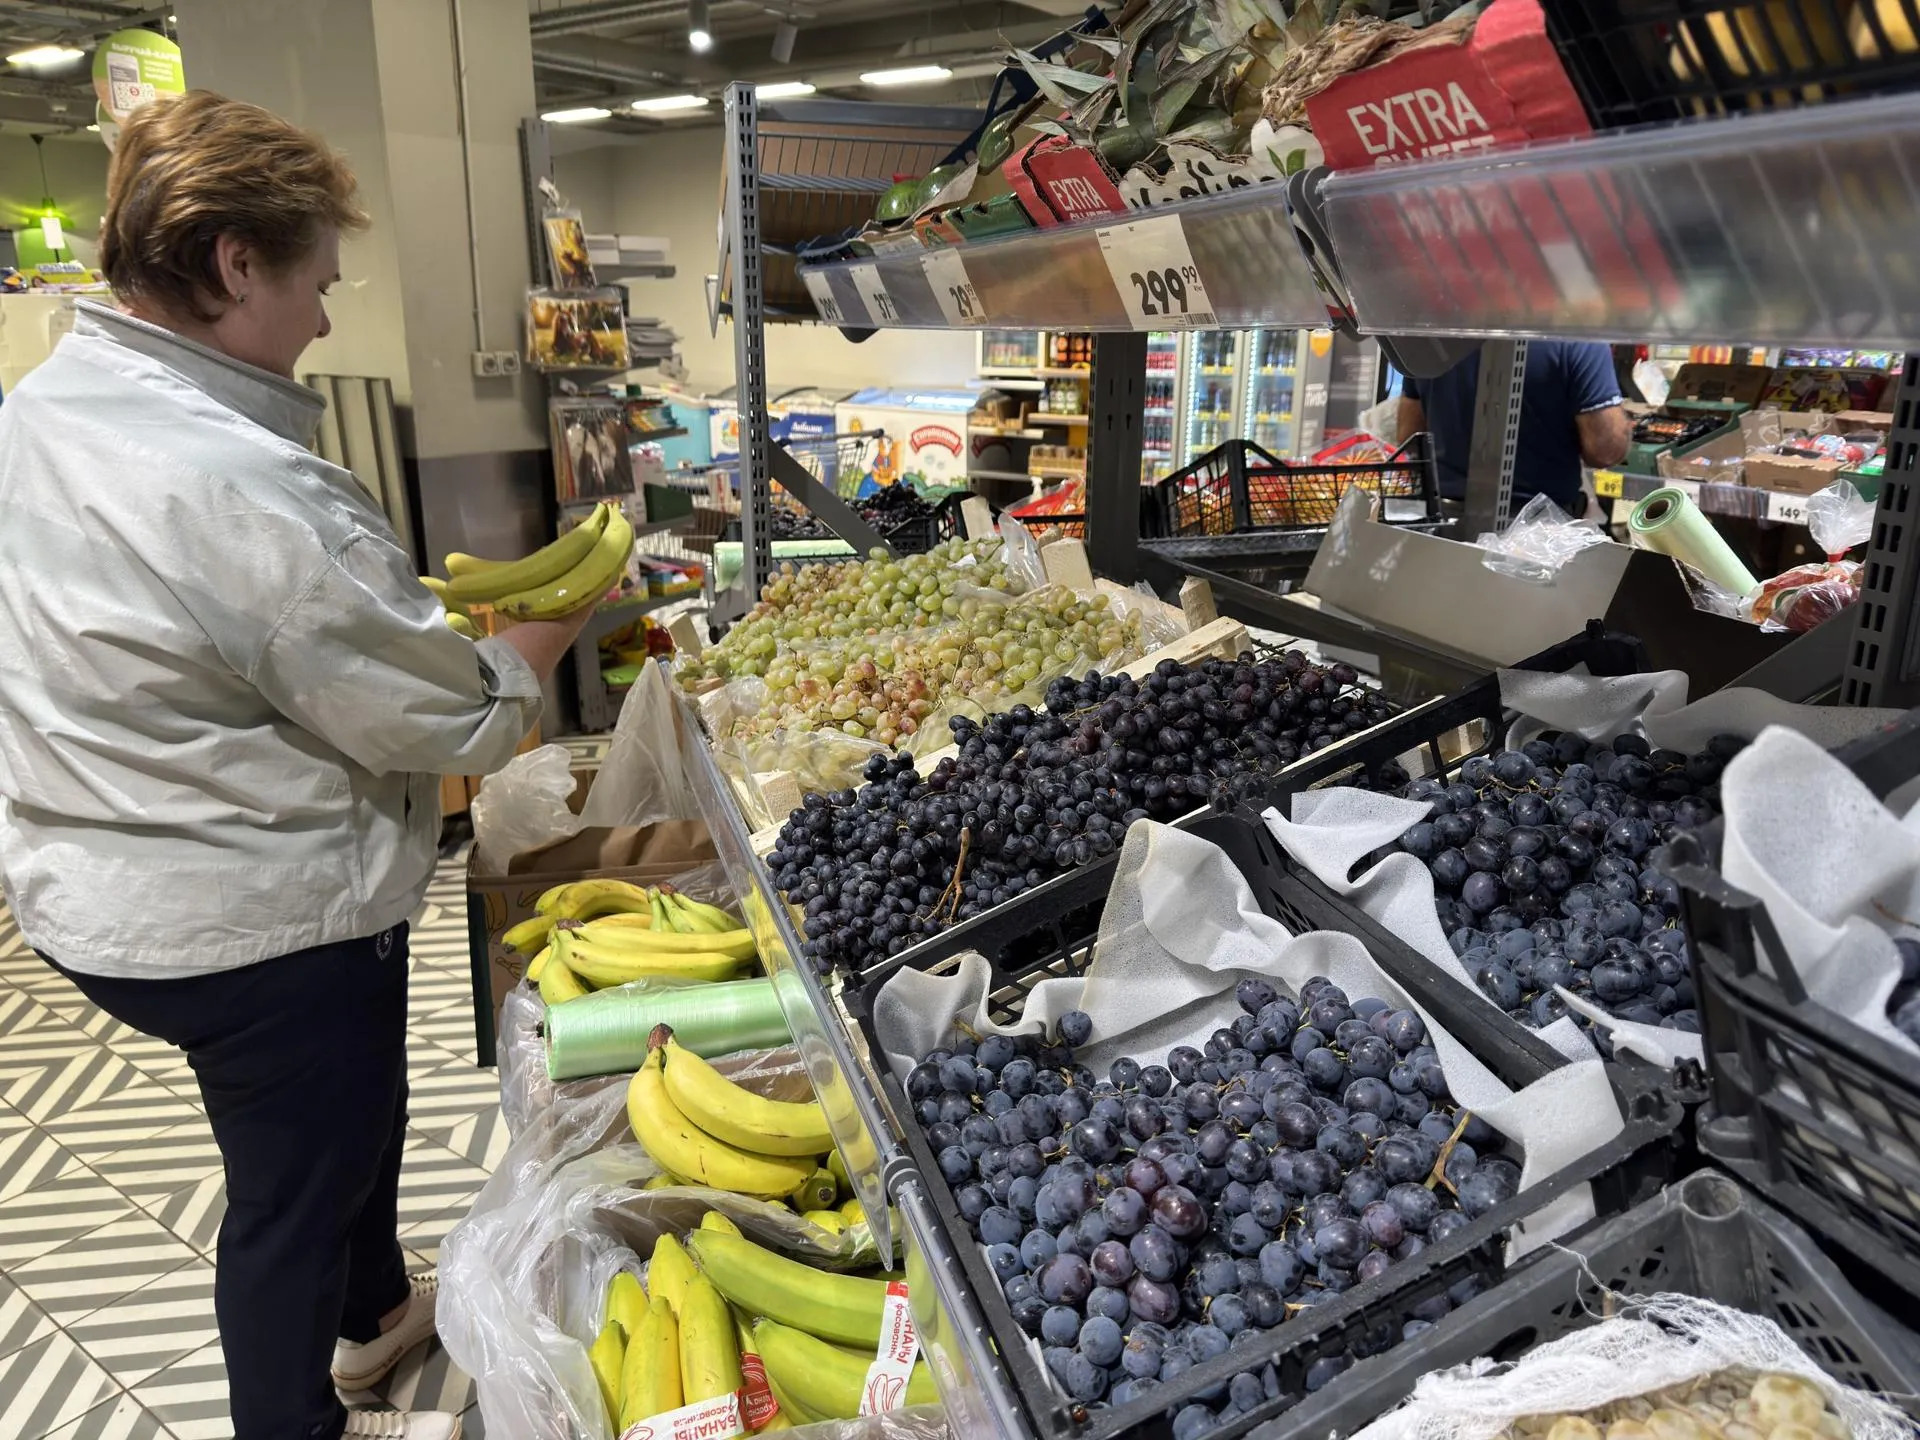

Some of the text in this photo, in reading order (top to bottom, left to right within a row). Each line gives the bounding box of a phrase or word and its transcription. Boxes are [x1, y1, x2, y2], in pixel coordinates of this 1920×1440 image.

[1347, 81, 1490, 155] EXTRA
[1048, 176, 1108, 211] EXTRA
[1130, 268, 1188, 315] 299
[1779, 506, 1801, 519] 149
